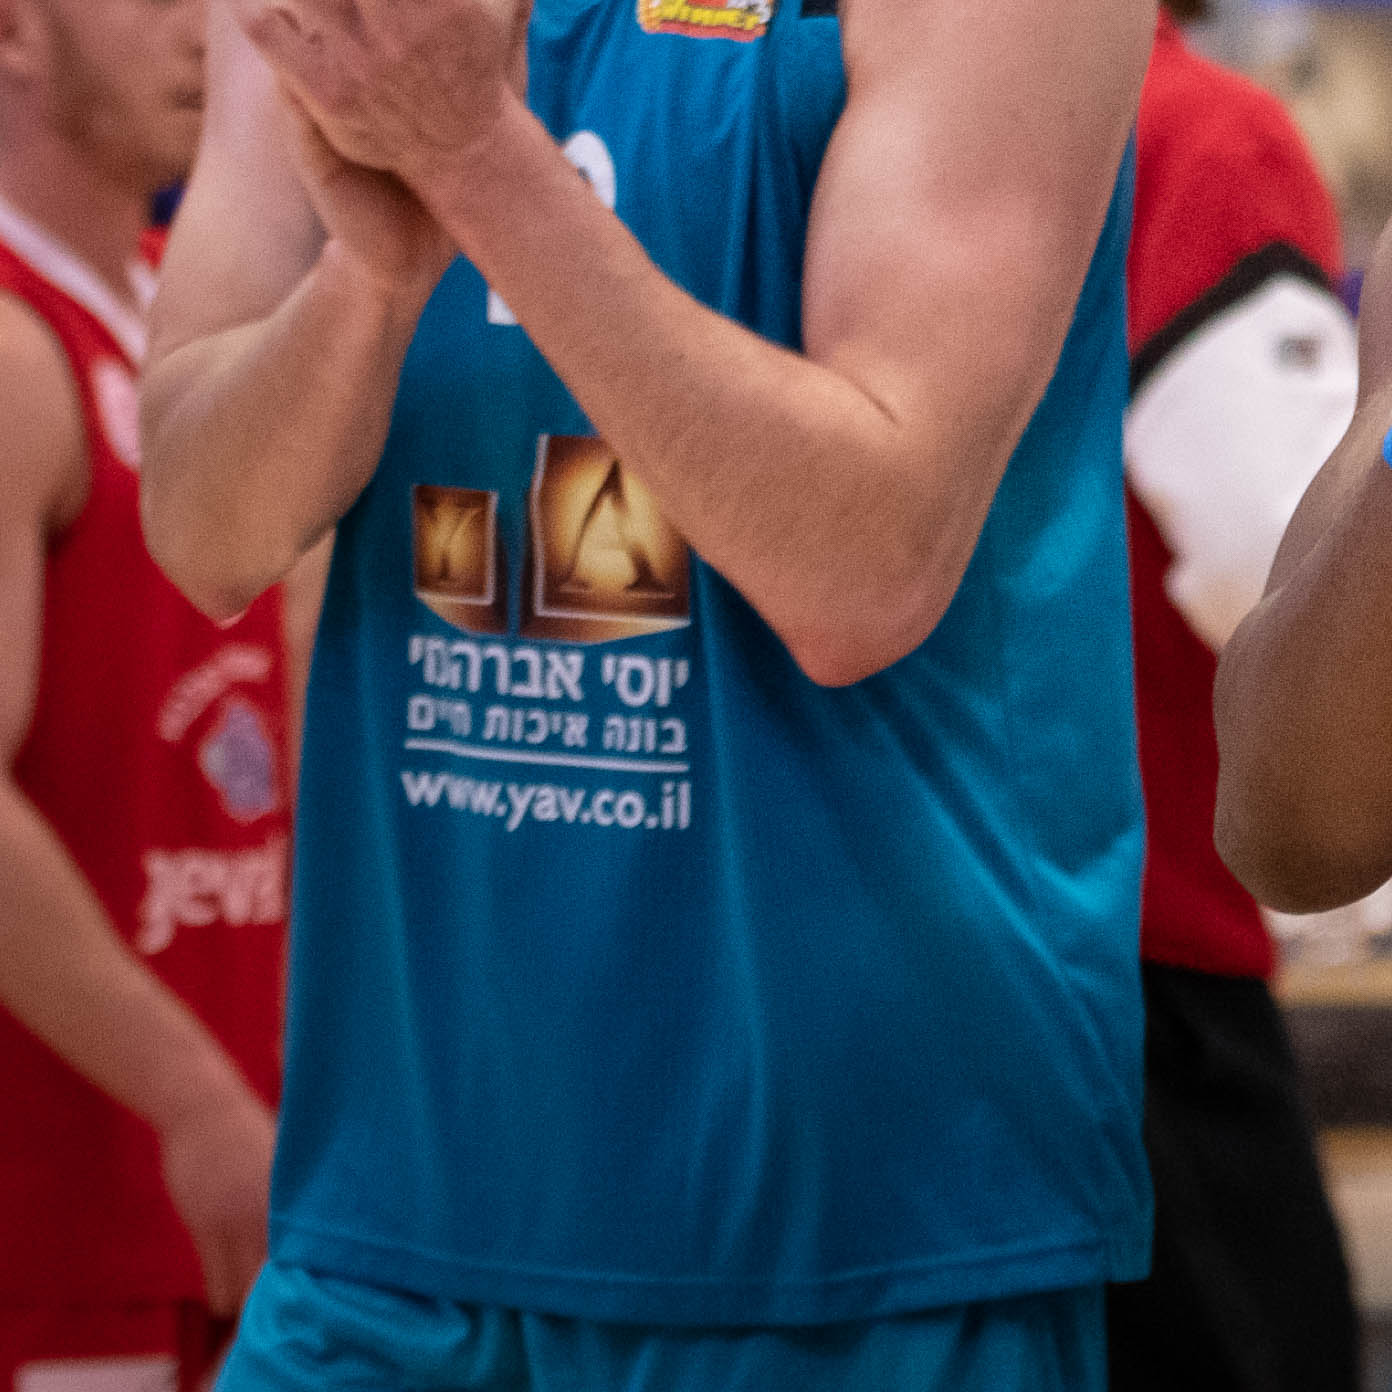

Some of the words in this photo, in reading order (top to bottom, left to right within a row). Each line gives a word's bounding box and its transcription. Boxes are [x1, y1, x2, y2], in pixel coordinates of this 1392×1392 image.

[556, 458, 676, 600] A
[408, 636, 584, 702] אברהמי
[600, 653, 689, 707] יוסי
[406, 693, 472, 738] חיים
[484, 706, 588, 747] איכות
[603, 714, 688, 755] בונה
[401, 770, 692, 832] www.yav.co.il
